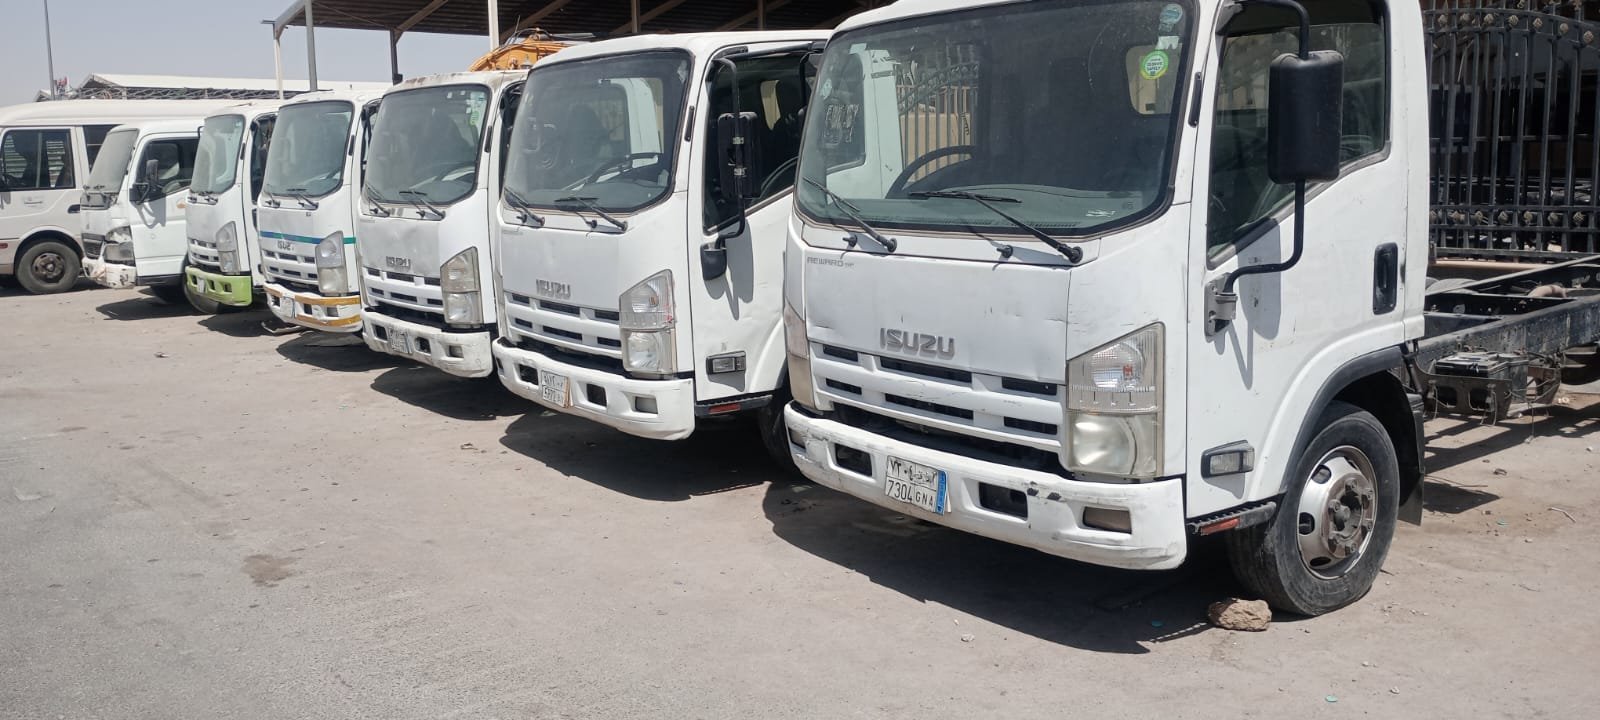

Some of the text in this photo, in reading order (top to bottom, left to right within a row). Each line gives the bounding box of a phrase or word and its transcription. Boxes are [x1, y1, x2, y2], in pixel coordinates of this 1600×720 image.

[536, 279, 571, 299] ISUZU
[880, 327, 955, 359] ISUZU
[887, 479, 912, 501] 7304
[915, 491, 934, 508] GNA
